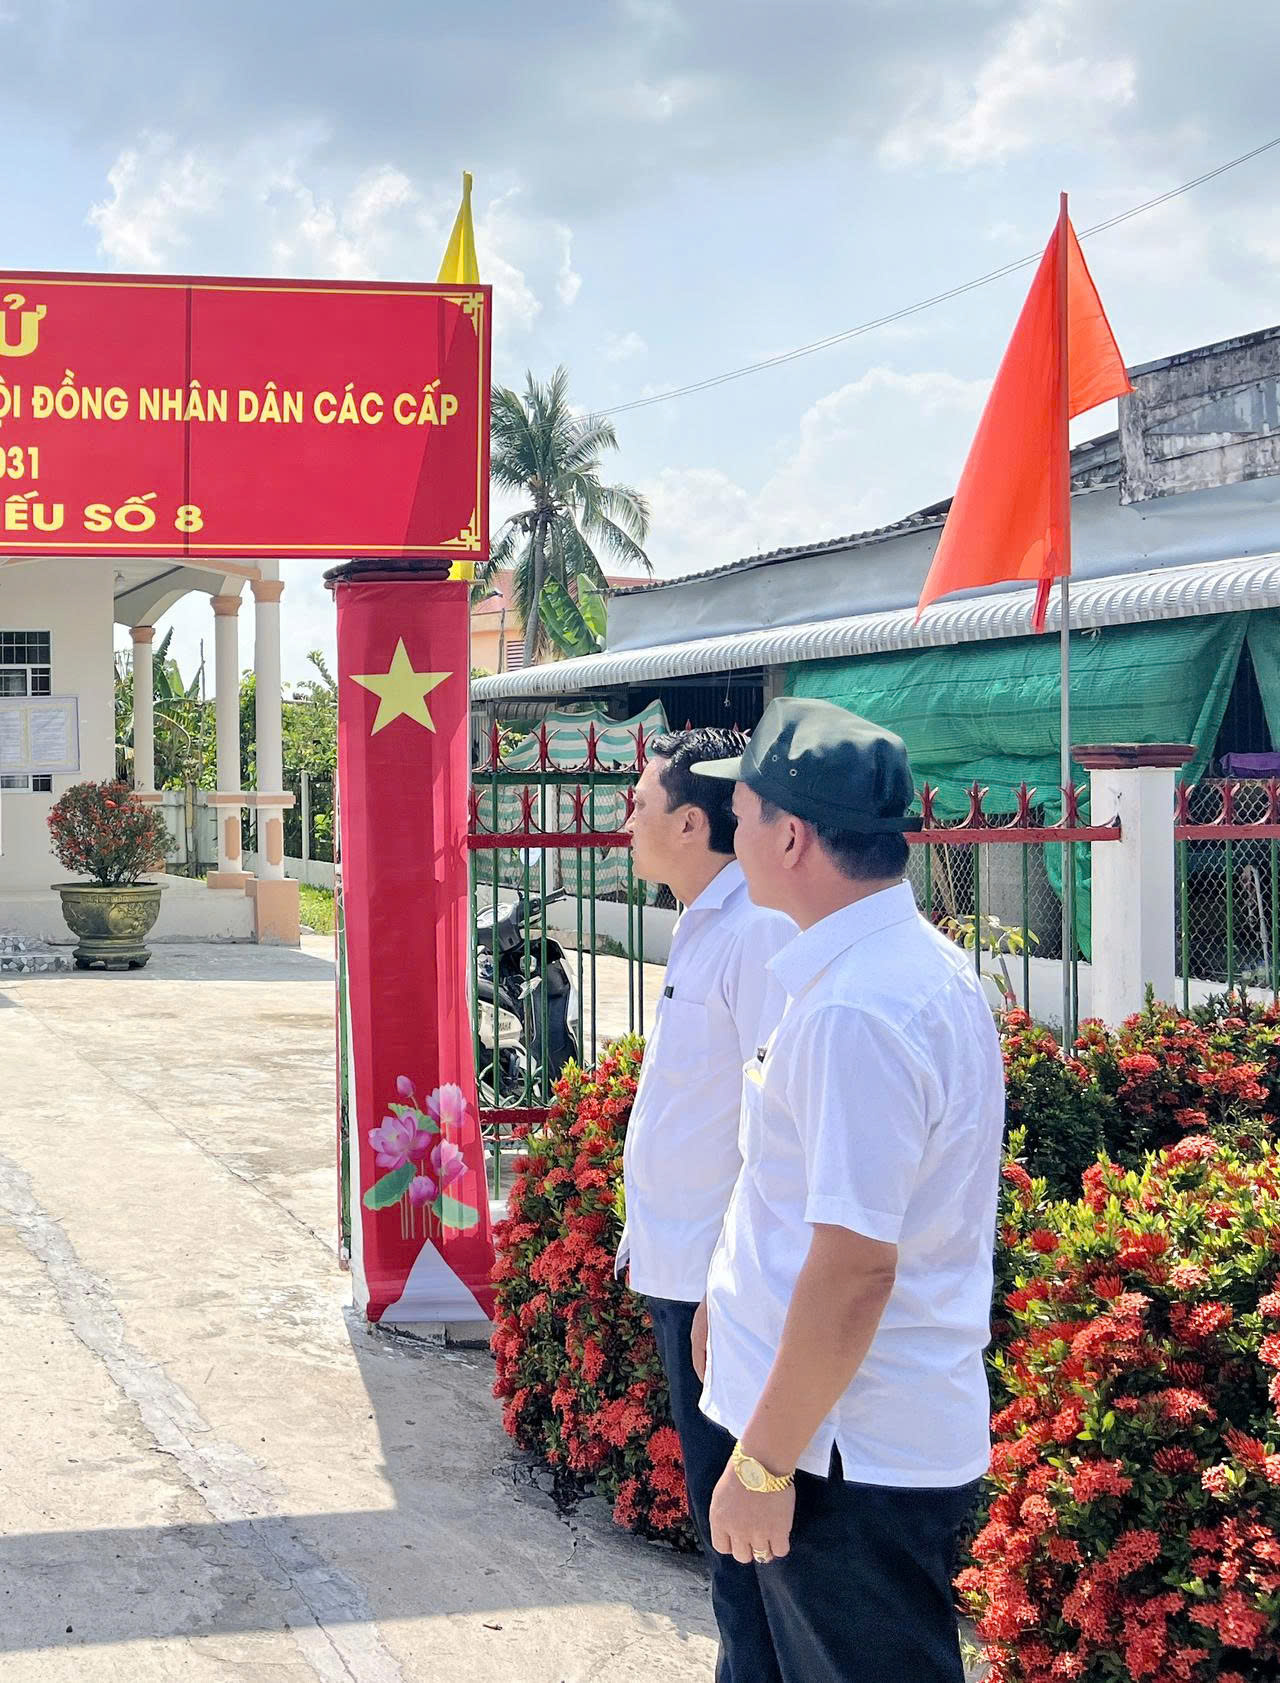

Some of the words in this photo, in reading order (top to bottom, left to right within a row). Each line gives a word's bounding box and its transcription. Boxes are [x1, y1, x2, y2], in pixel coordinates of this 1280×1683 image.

[31, 368, 129, 421] ĐỒNG
[139, 379, 228, 422] NHÂN
[238, 381, 304, 424] DÂN
[313, 382, 384, 425] CÁC
[393, 378, 458, 426] CẤP
[83, 491, 157, 533] SỐ
[174, 504, 204, 533] 8
